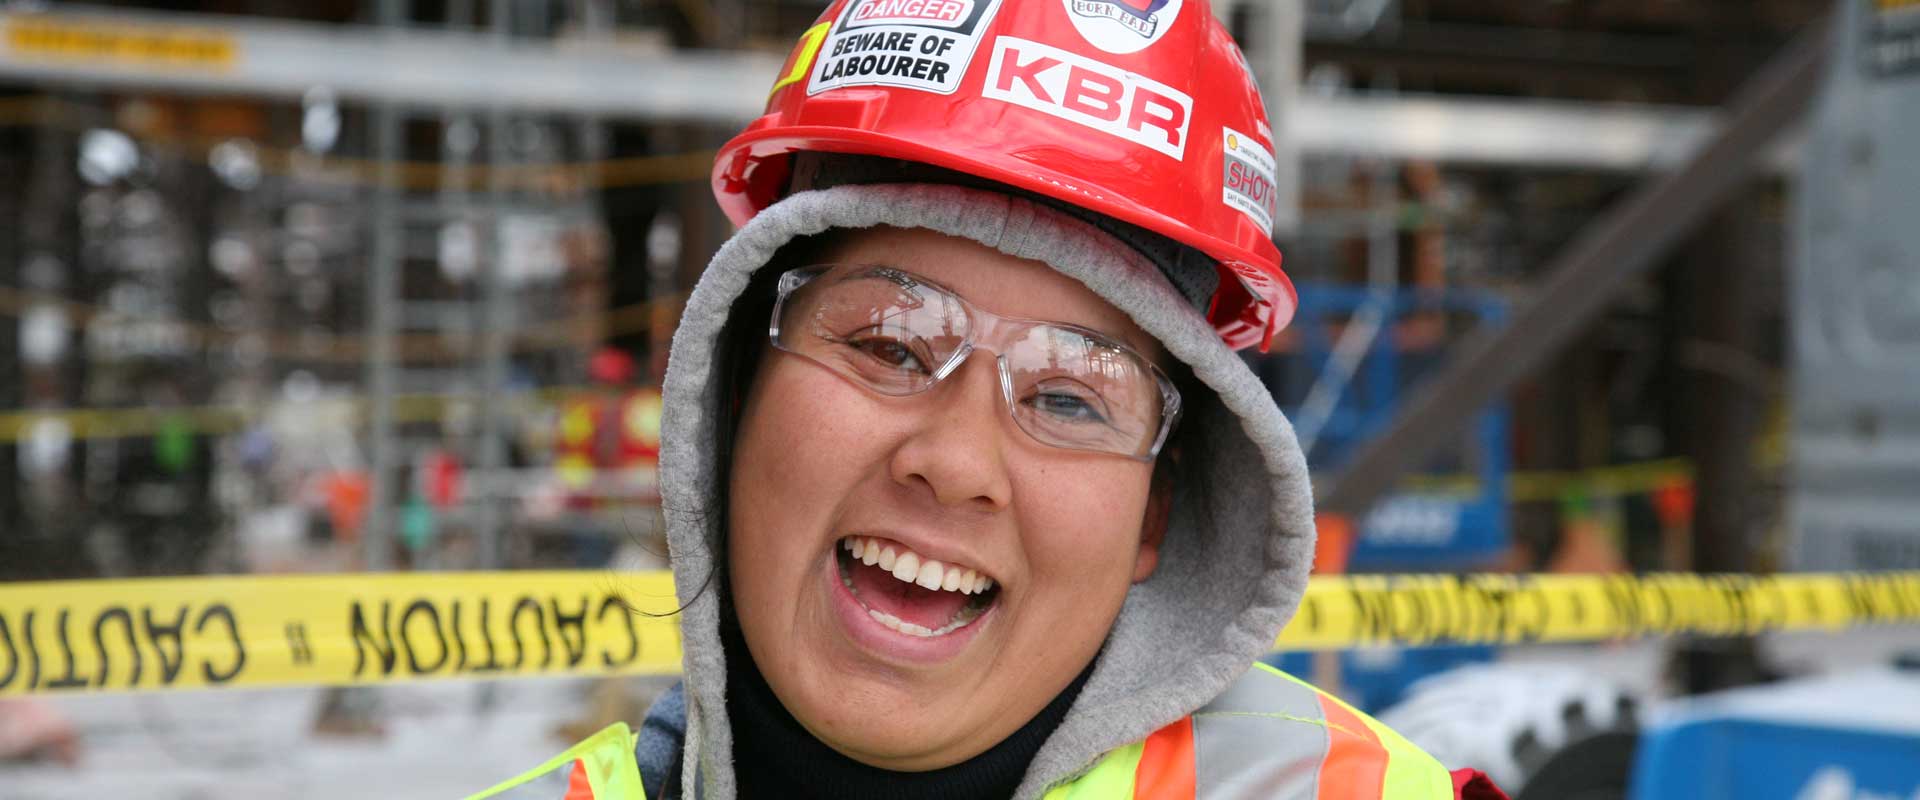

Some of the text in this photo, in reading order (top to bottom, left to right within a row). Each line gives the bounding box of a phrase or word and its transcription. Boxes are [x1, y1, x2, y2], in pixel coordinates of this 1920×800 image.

[856, 0, 961, 20] DANGER
[1077, 1, 1148, 33] BORN BAD
[831, 32, 955, 58] BEWARE OF
[820, 55, 950, 84] LABOURER
[996, 47, 1185, 147] KBR
[1228, 161, 1269, 207] SHOT
[349, 595, 639, 677] CAUTION
